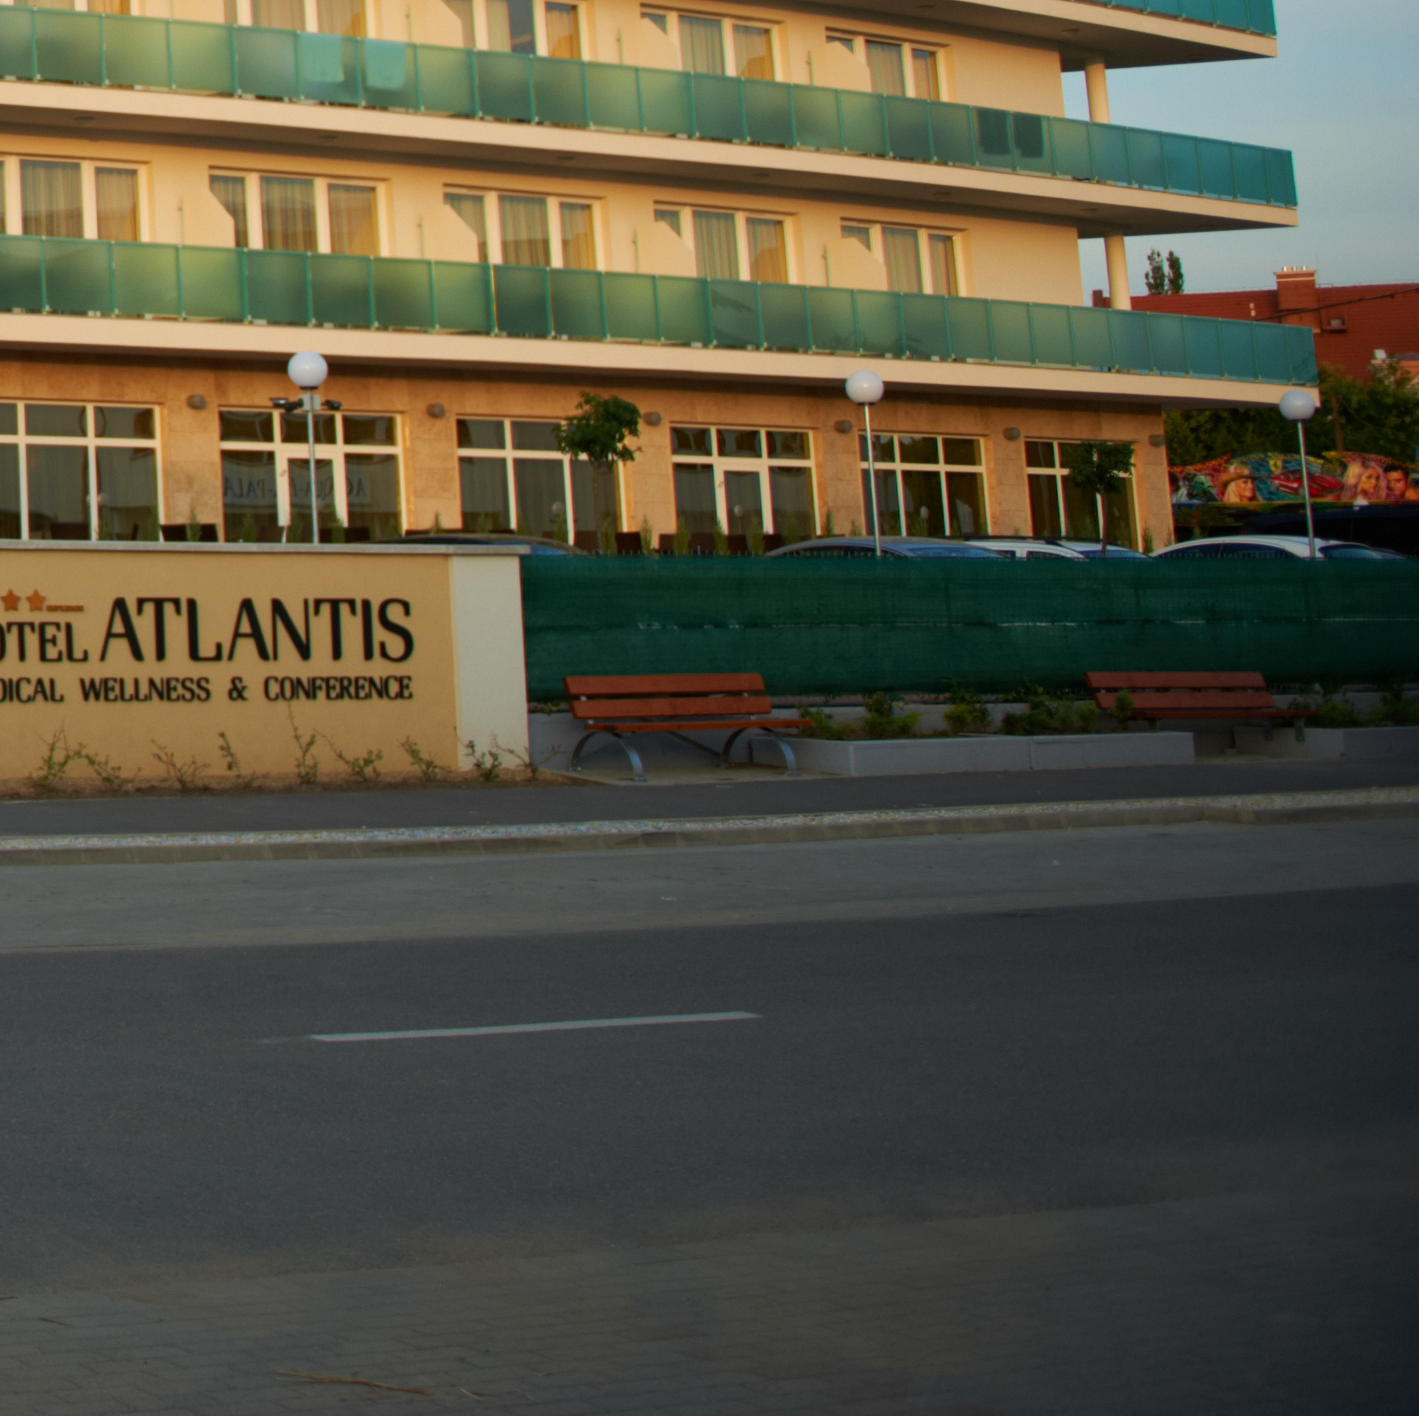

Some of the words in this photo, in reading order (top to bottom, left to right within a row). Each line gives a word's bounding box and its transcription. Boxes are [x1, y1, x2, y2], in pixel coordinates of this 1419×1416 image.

[99, 597, 415, 663] ATLANTIS
[79, 677, 211, 702] WELLNESS
[228, 676, 249, 702] &
[263, 675, 413, 701] CONFERENCE
